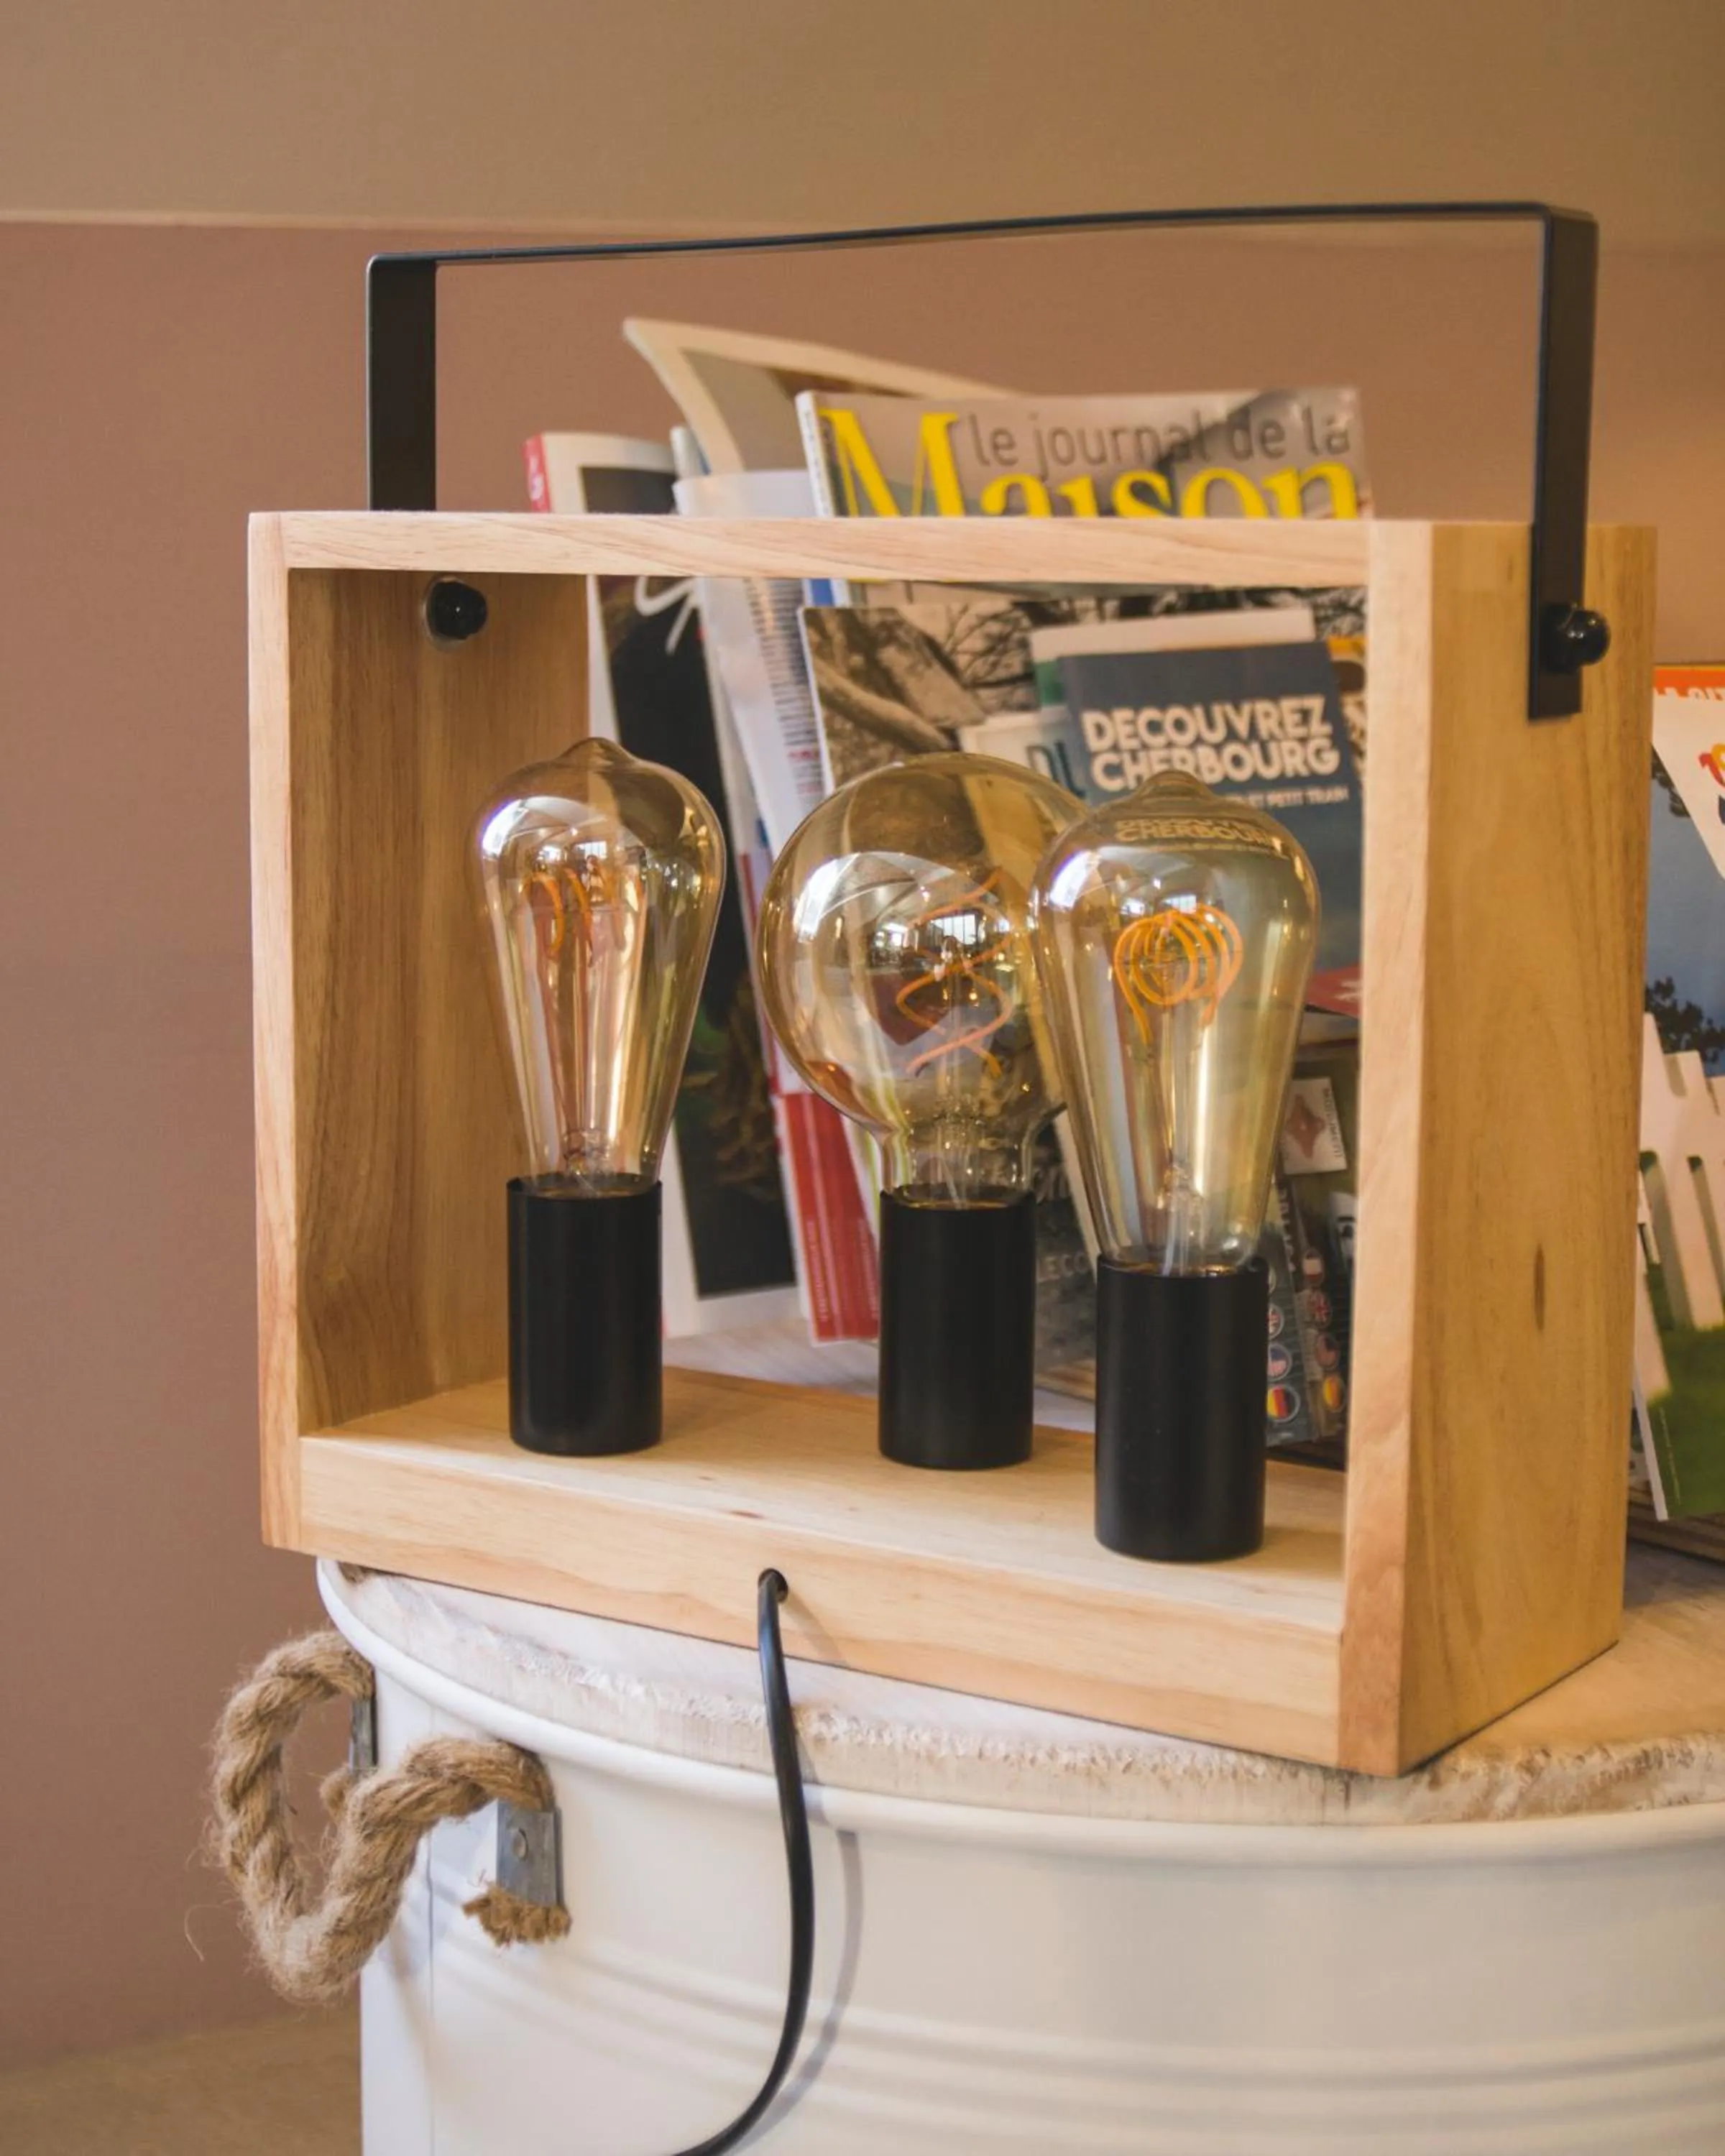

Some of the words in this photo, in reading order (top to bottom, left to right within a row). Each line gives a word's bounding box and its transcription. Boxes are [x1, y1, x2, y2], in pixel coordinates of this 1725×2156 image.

[968, 410, 1018, 466] le
[1029, 407, 1211, 483] journal
[1228, 407, 1287, 461] de
[1302, 405, 1351, 456] la
[1081, 695, 1333, 752] DECOUVREZ
[1091, 737, 1340, 792] CHERBOURG
